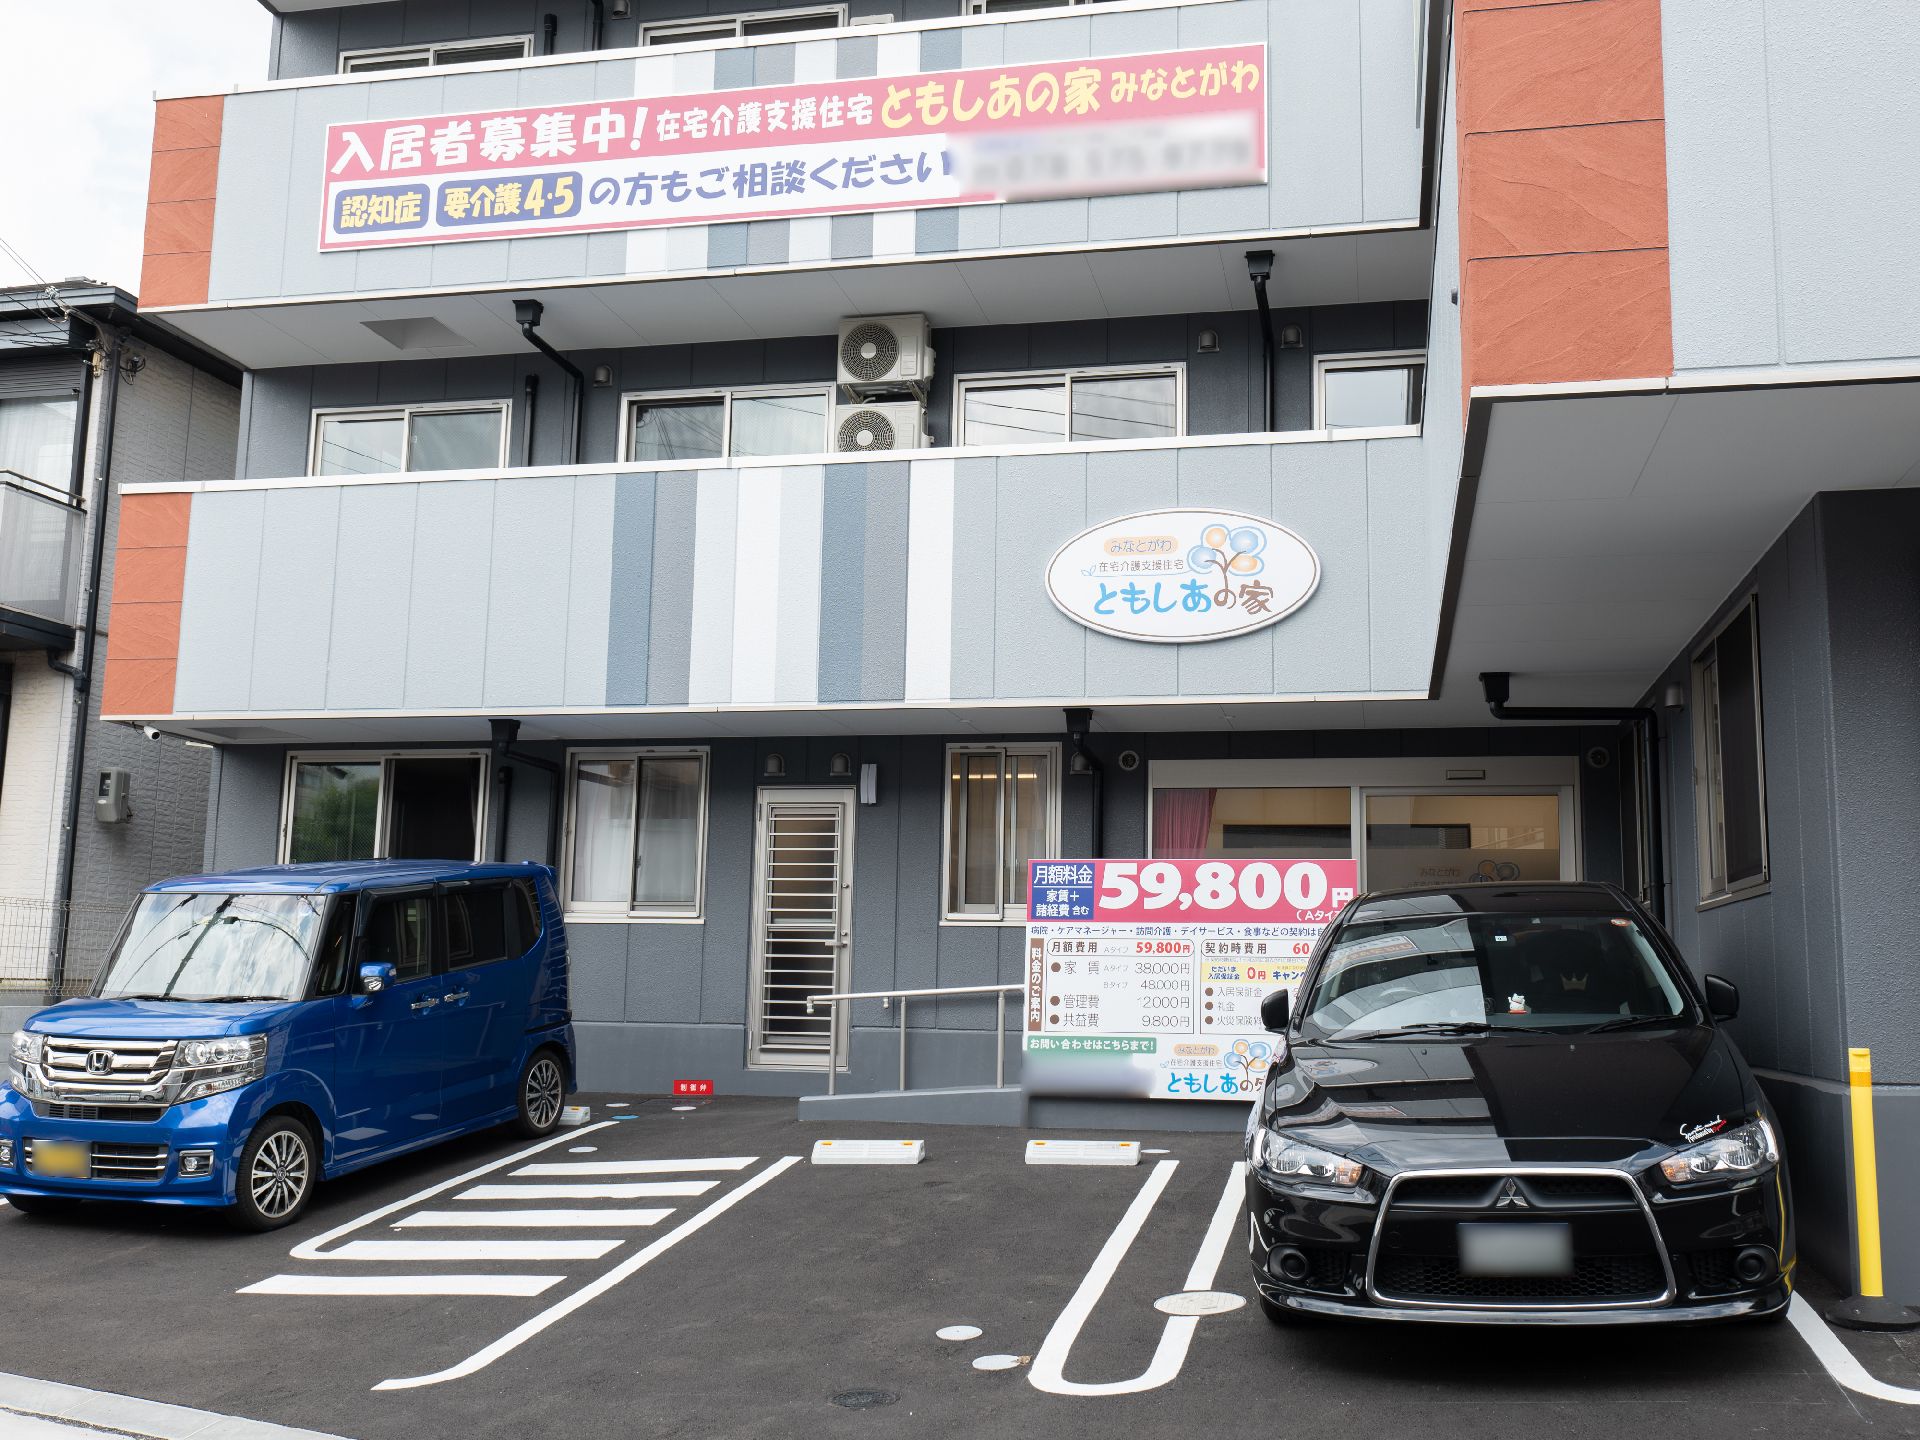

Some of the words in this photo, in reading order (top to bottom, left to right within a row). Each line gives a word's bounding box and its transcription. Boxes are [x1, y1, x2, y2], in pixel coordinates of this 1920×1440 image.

[331, 106, 648, 174] 入居者募集中!
[656, 92, 873, 142] 在宅介護支援住宅
[881, 67, 1101, 128] ともしあの家
[1111, 60, 1259, 103] みなとがわ
[340, 191, 422, 227] 認知症
[589, 151, 951, 206] の方もご相談ください
[1110, 539, 1172, 553] みなとがわ
[1099, 559, 1184, 572] 在宅介護支援住宅
[1093, 578, 1273, 614] ともしあの家
[1034, 865, 1092, 884] 月額料金
[1036, 903, 1069, 917] 諸経費
[1072, 905, 1089, 915] 含む
[1051, 941, 1098, 953] 月額費用
[1135, 941, 1191, 954] 59,800円
[1205, 942, 1267, 955] 契約時費用
[1063, 994, 1100, 1009] 管理費
[1217, 1002, 1236, 1012] 礼金
[1063, 1012, 1099, 1027] 共益費
